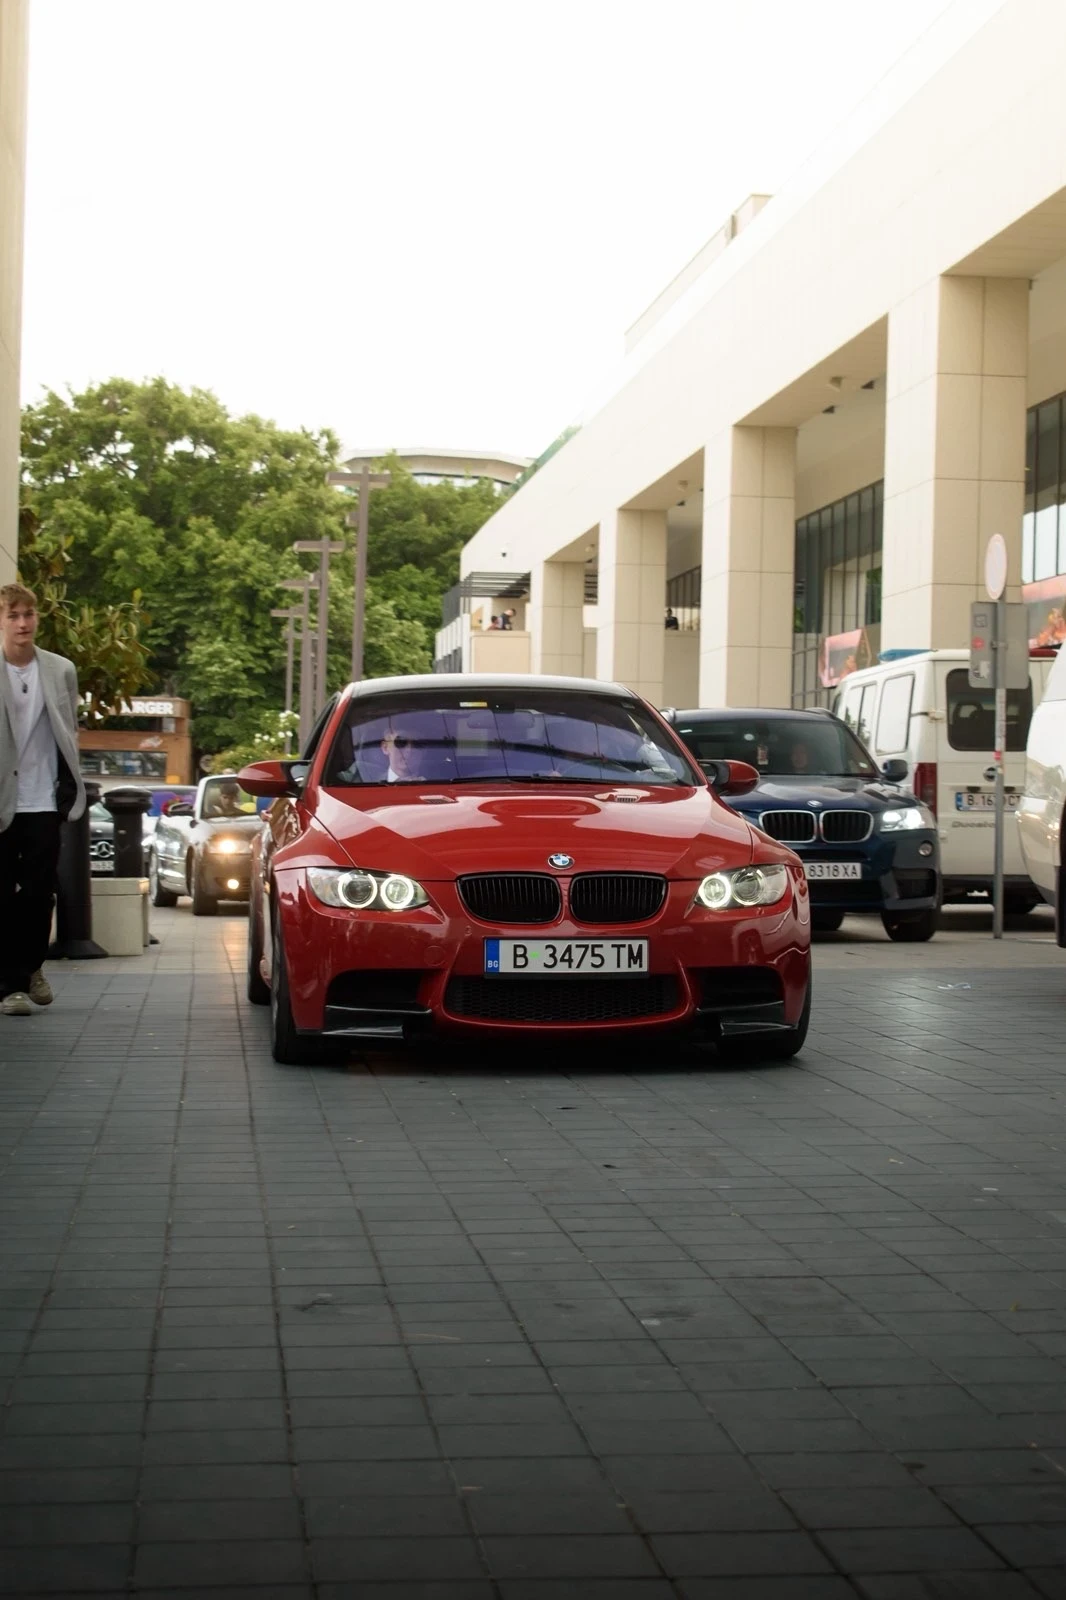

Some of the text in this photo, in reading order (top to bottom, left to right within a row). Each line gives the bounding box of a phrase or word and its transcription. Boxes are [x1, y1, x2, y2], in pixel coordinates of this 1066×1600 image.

[808, 864, 858, 878] 8318 XA
[487, 944, 643, 969] BG B 3475 TM
